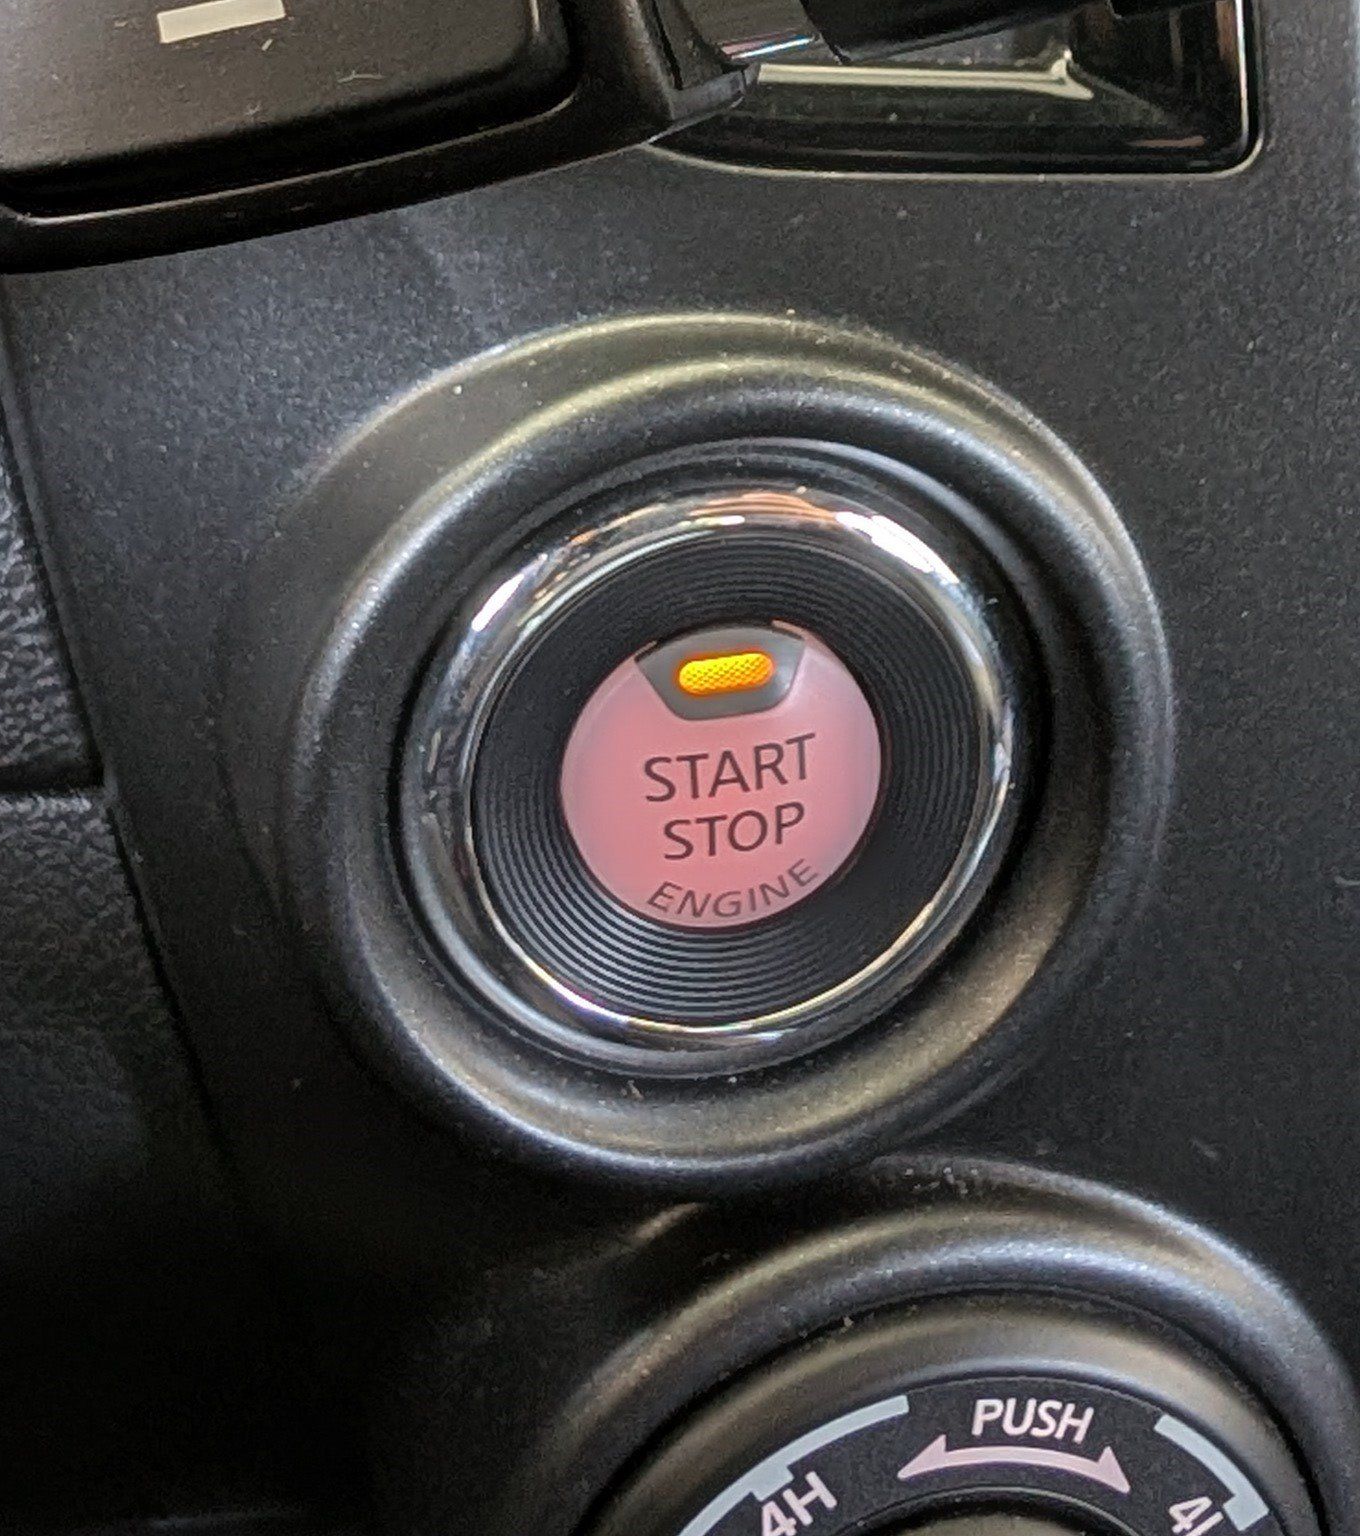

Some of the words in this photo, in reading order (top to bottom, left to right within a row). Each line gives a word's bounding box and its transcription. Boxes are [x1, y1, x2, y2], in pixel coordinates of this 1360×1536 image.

[643, 732, 817, 803] START
[663, 801, 805, 860] STOP
[646, 858, 818, 918] ENGINE
[971, 1397, 1095, 1444] PUSH
[759, 1471, 838, 1536] 4H
